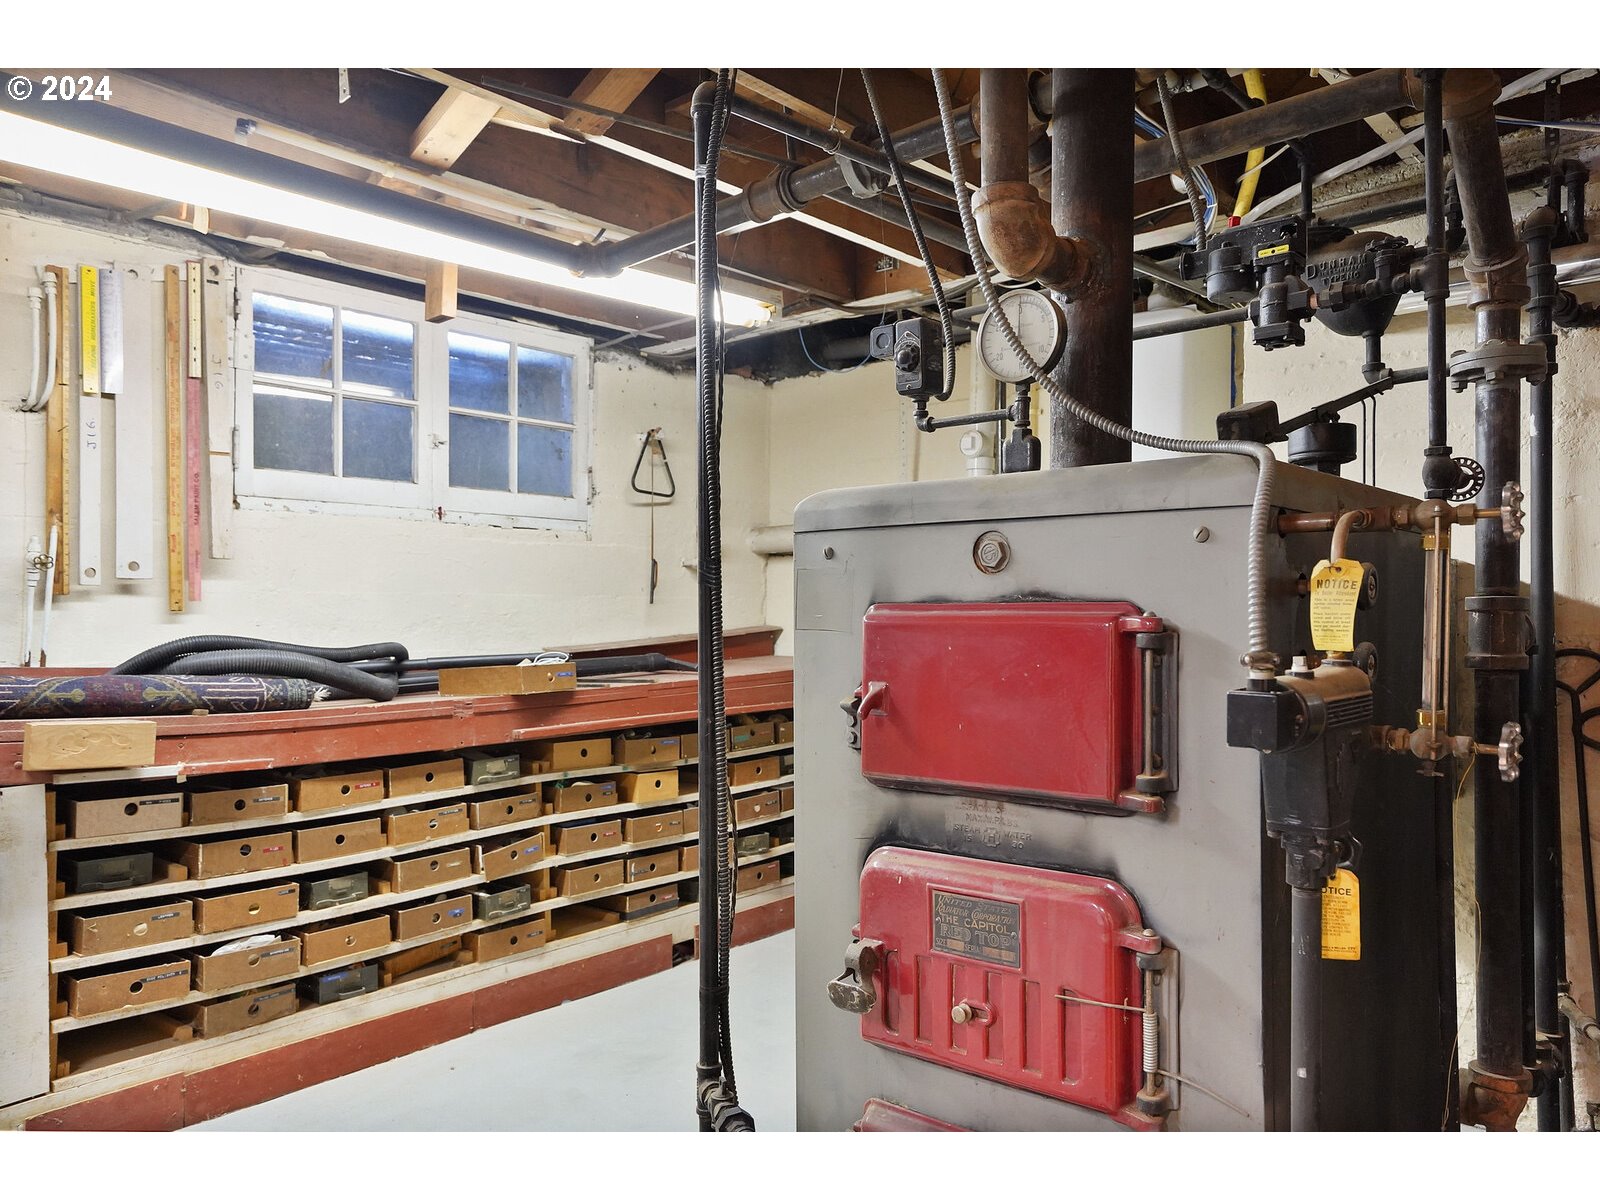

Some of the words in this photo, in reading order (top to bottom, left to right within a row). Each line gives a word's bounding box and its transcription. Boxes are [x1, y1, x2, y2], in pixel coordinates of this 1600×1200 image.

[1305, 254, 1366, 279] DUNHAM
[996, 352, 1004, 362] 20
[1316, 579, 1358, 590] NOTICE
[954, 823, 981, 834] STEAM
[1004, 830, 1033, 841] WATER
[1321, 886, 1352, 897] OTICE
[936, 901, 969, 918] RADIATOR
[938, 895, 973, 909] UNITED
[976, 902, 1013, 915] STATES
[941, 913, 959, 925] THE
[964, 918, 1010, 935] CAPITOL
[940, 923, 972, 942] RED
[974, 930, 1013, 949] TOP
